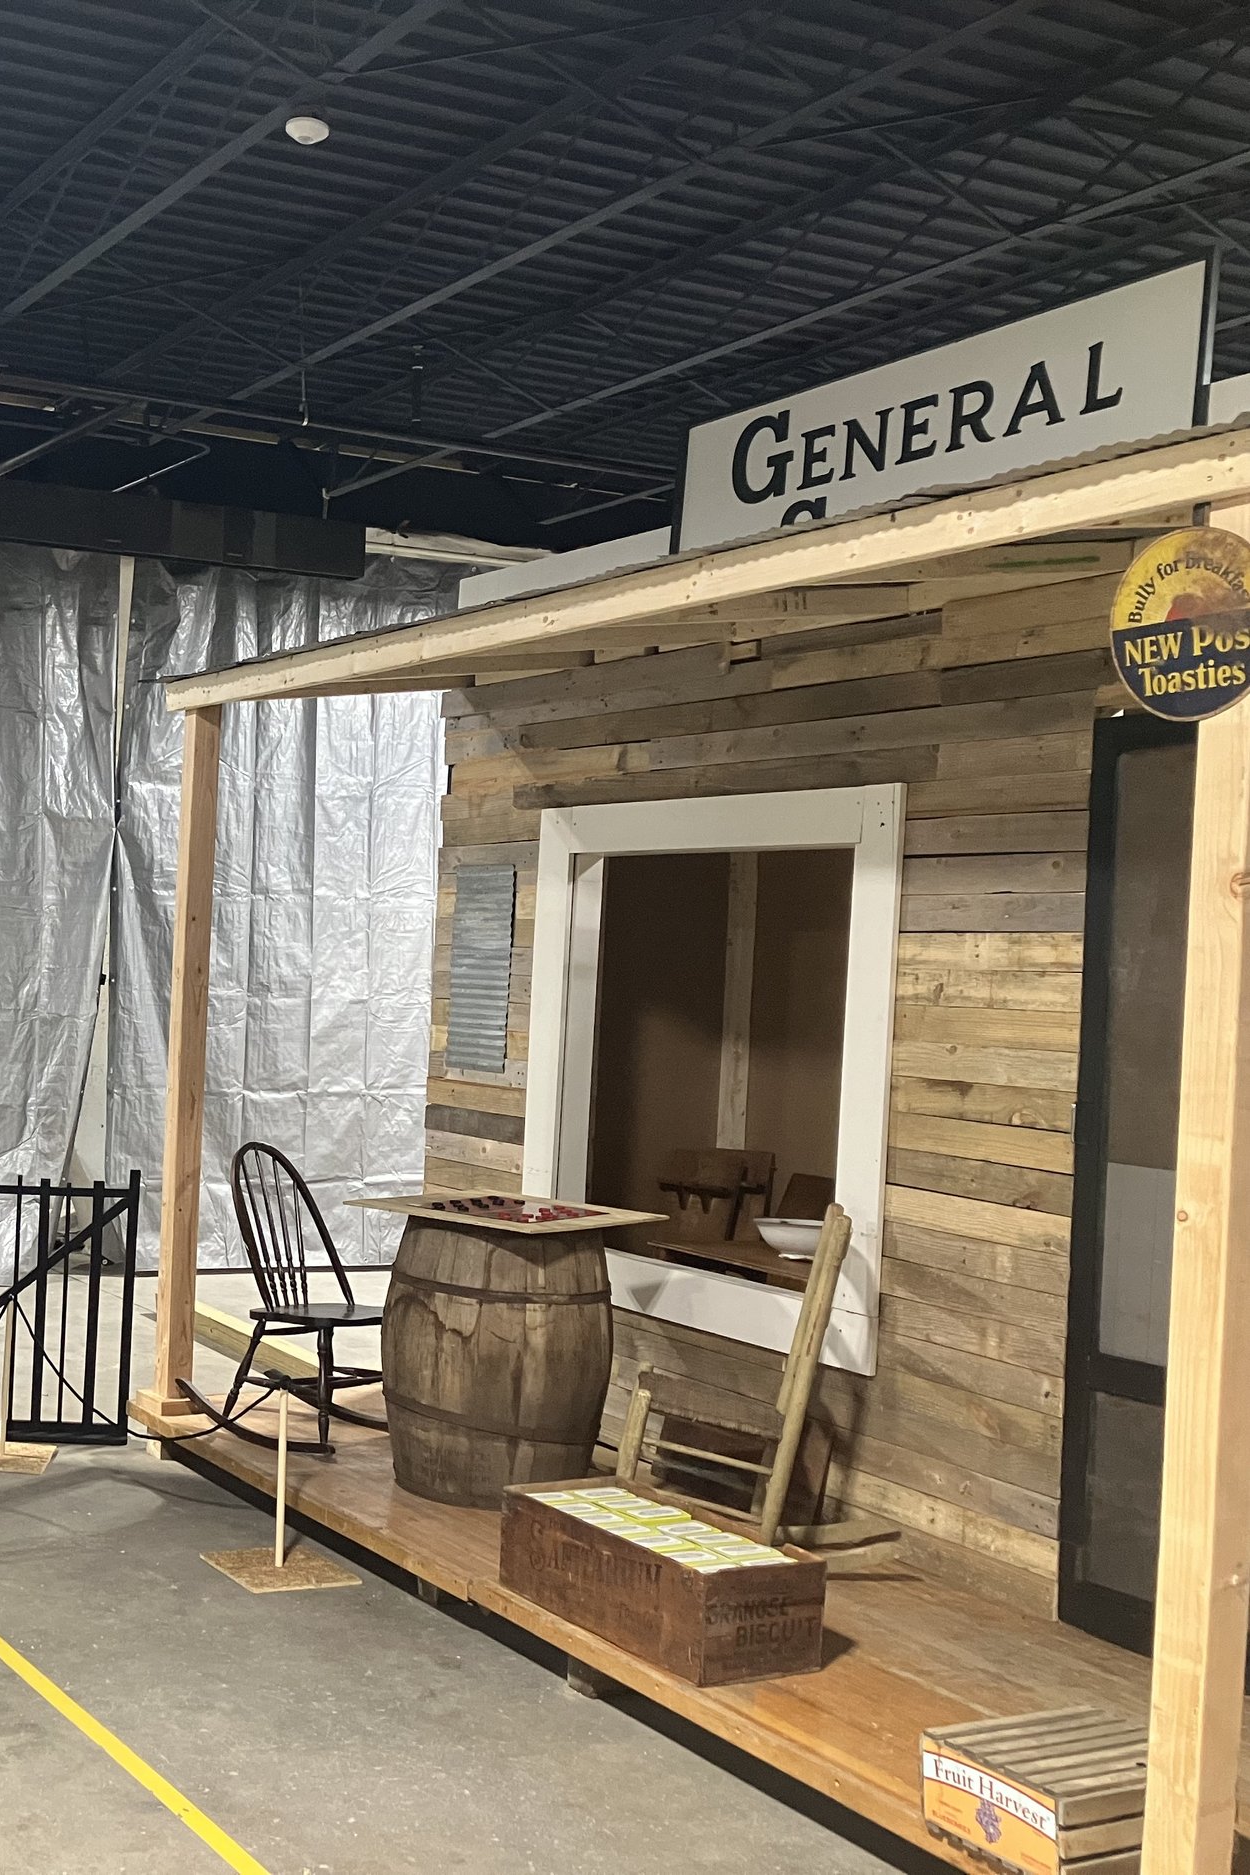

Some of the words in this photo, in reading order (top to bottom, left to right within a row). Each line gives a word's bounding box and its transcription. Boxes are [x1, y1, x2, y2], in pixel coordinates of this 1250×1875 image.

[731, 341, 1124, 504] GENERAL
[1128, 576, 1157, 623] Bully
[1156, 558, 1180, 581] for
[1124, 631, 1183, 667] NEW
[1138, 659, 1246, 698] Toasties
[933, 1758, 974, 1791] Fruit
[978, 1775, 1047, 1830] Harvest
